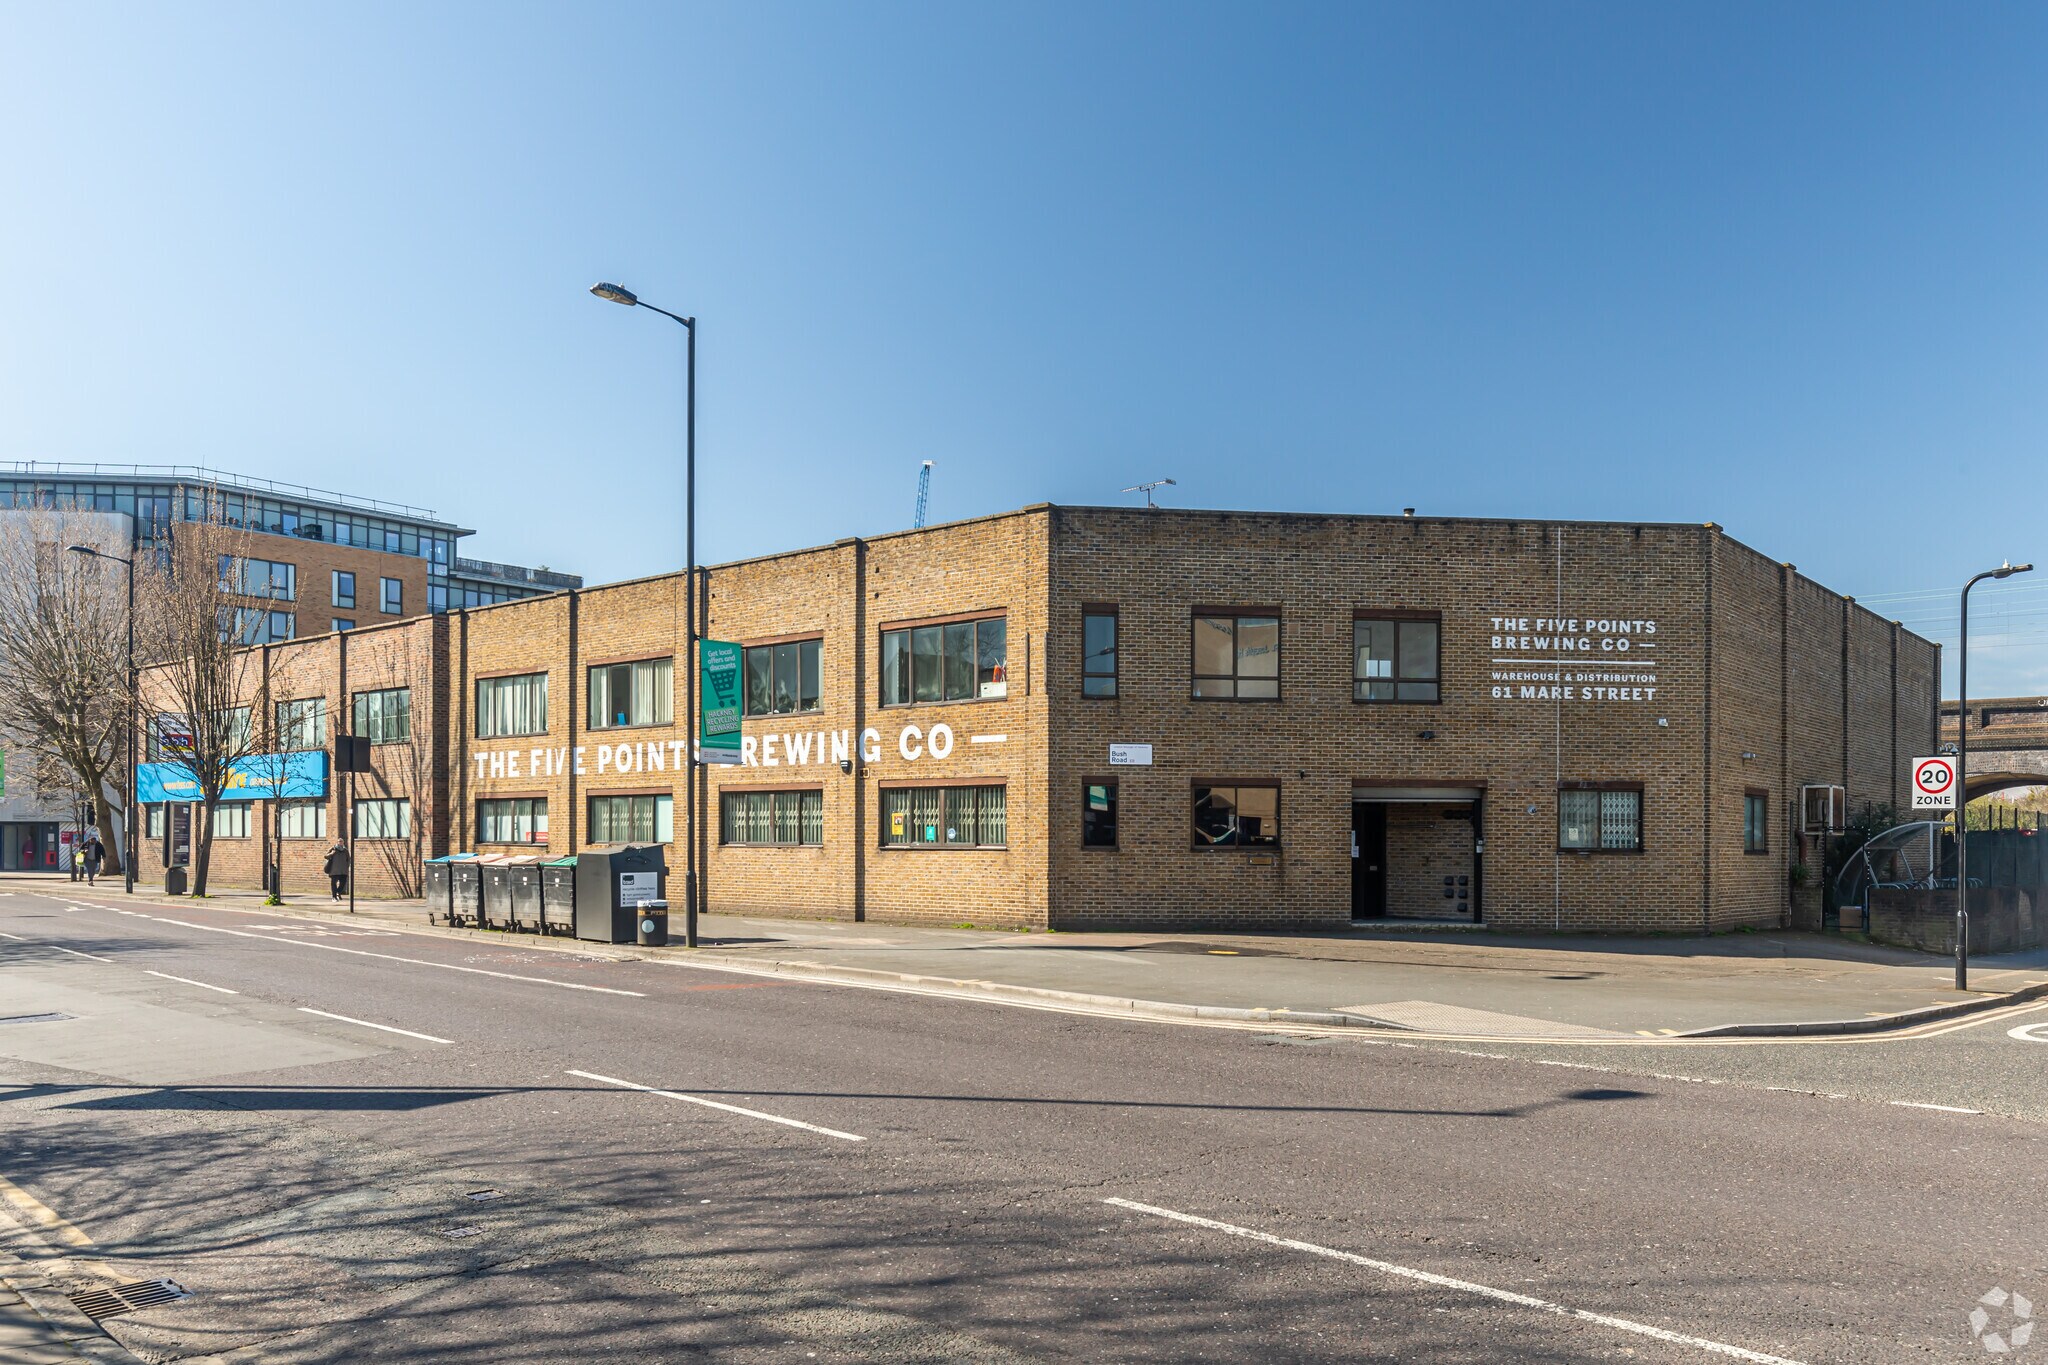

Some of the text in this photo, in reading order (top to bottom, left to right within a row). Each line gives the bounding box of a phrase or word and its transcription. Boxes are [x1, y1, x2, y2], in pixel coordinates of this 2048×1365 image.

[1491, 617, 1656, 634] THE FIVE POINTS
[1491, 636, 1630, 651] BREWING CO
[1492, 672, 1656, 682] WAREHOUSE & DISTRIBUTION
[1492, 686, 1656, 700] 61 MARE STREET
[708, 708, 735, 717] HACKNEY
[707, 715, 739, 726] RECYCLING
[709, 723, 738, 732] REWARDS
[474, 751, 519, 778] THE
[530, 747, 586, 776] FIVE
[720, 728, 880, 767] REWING
[899, 723, 953, 760] CO
[1922, 770, 1948, 783] 20
[1916, 796, 1951, 805] ZONE
